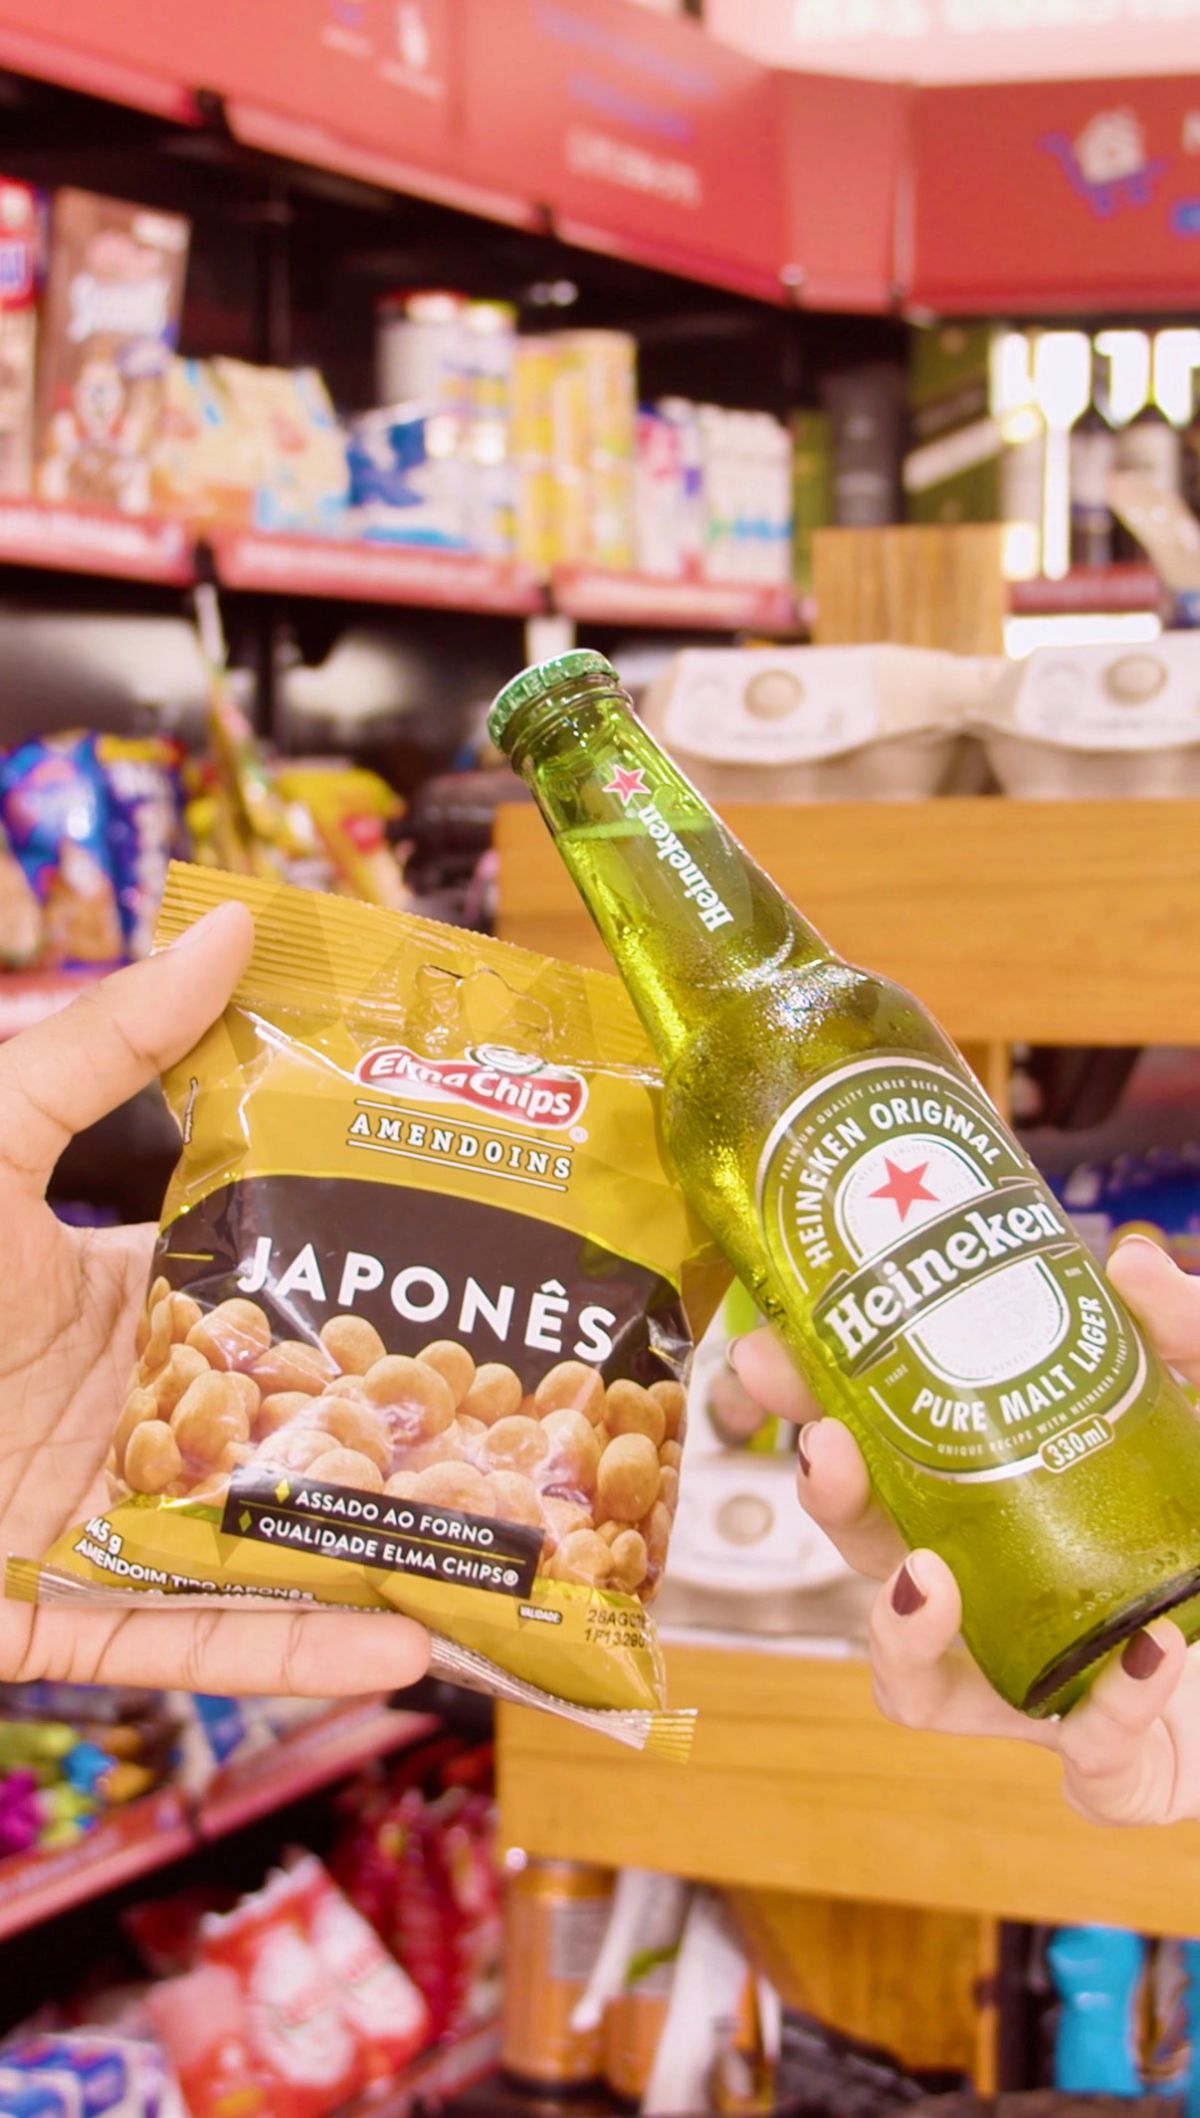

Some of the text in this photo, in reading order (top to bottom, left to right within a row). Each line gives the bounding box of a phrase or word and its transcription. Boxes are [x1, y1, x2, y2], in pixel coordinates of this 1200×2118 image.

[638, 803, 734, 932] Heineken
[816, 1088, 864, 1124] QUALITY
[350, 1113, 572, 1179] AMENDOINS
[795, 1117, 867, 1268] HEINEKEN
[869, 1097, 1001, 1165] ORIGINAL
[237, 1237, 616, 1362] JAPONÊS
[823, 1202, 1066, 1360] Heineken
[912, 1387, 987, 1431] PURE
[999, 1364, 1076, 1424] MALT
[1069, 1295, 1107, 1374] LAGER
[1036, 1413, 1068, 1434] WITH
[1047, 1419, 1109, 1467] 330ml
[108, 1535, 123, 1555] g
[259, 1516, 378, 1558] QUALIDADE
[382, 1544, 437, 1571] ELMA
[295, 1490, 493, 1546] ASSADO AO FORNO
[75, 1539, 167, 1584] AMENDOIM
